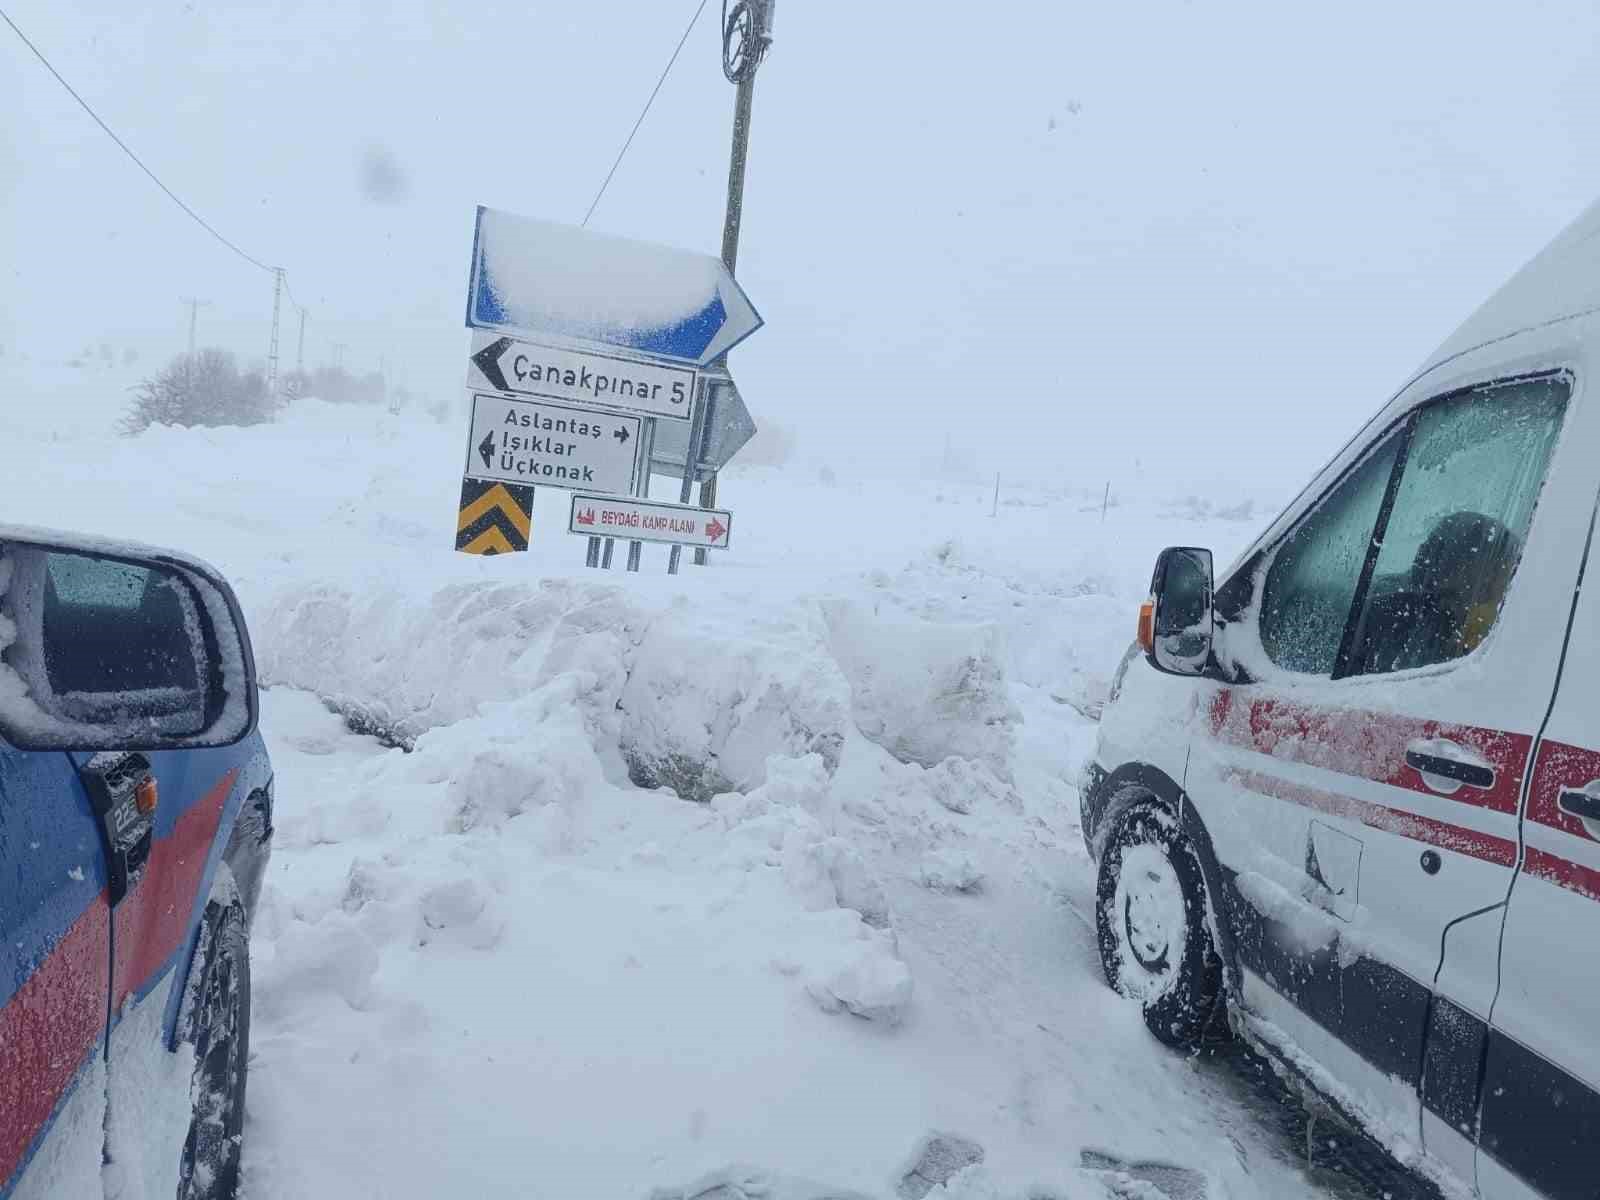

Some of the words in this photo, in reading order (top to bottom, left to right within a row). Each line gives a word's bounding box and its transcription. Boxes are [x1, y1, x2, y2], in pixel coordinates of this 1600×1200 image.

[513, 354, 662, 398] Çanakpınar
[669, 381, 685, 404] 5
[504, 409, 602, 438] Aslantaş
[503, 431, 576, 456] Işıklar
[501, 451, 594, 482] Üçkonak
[642, 515, 668, 531] KAMP
[669, 519, 695, 535] ALANI
